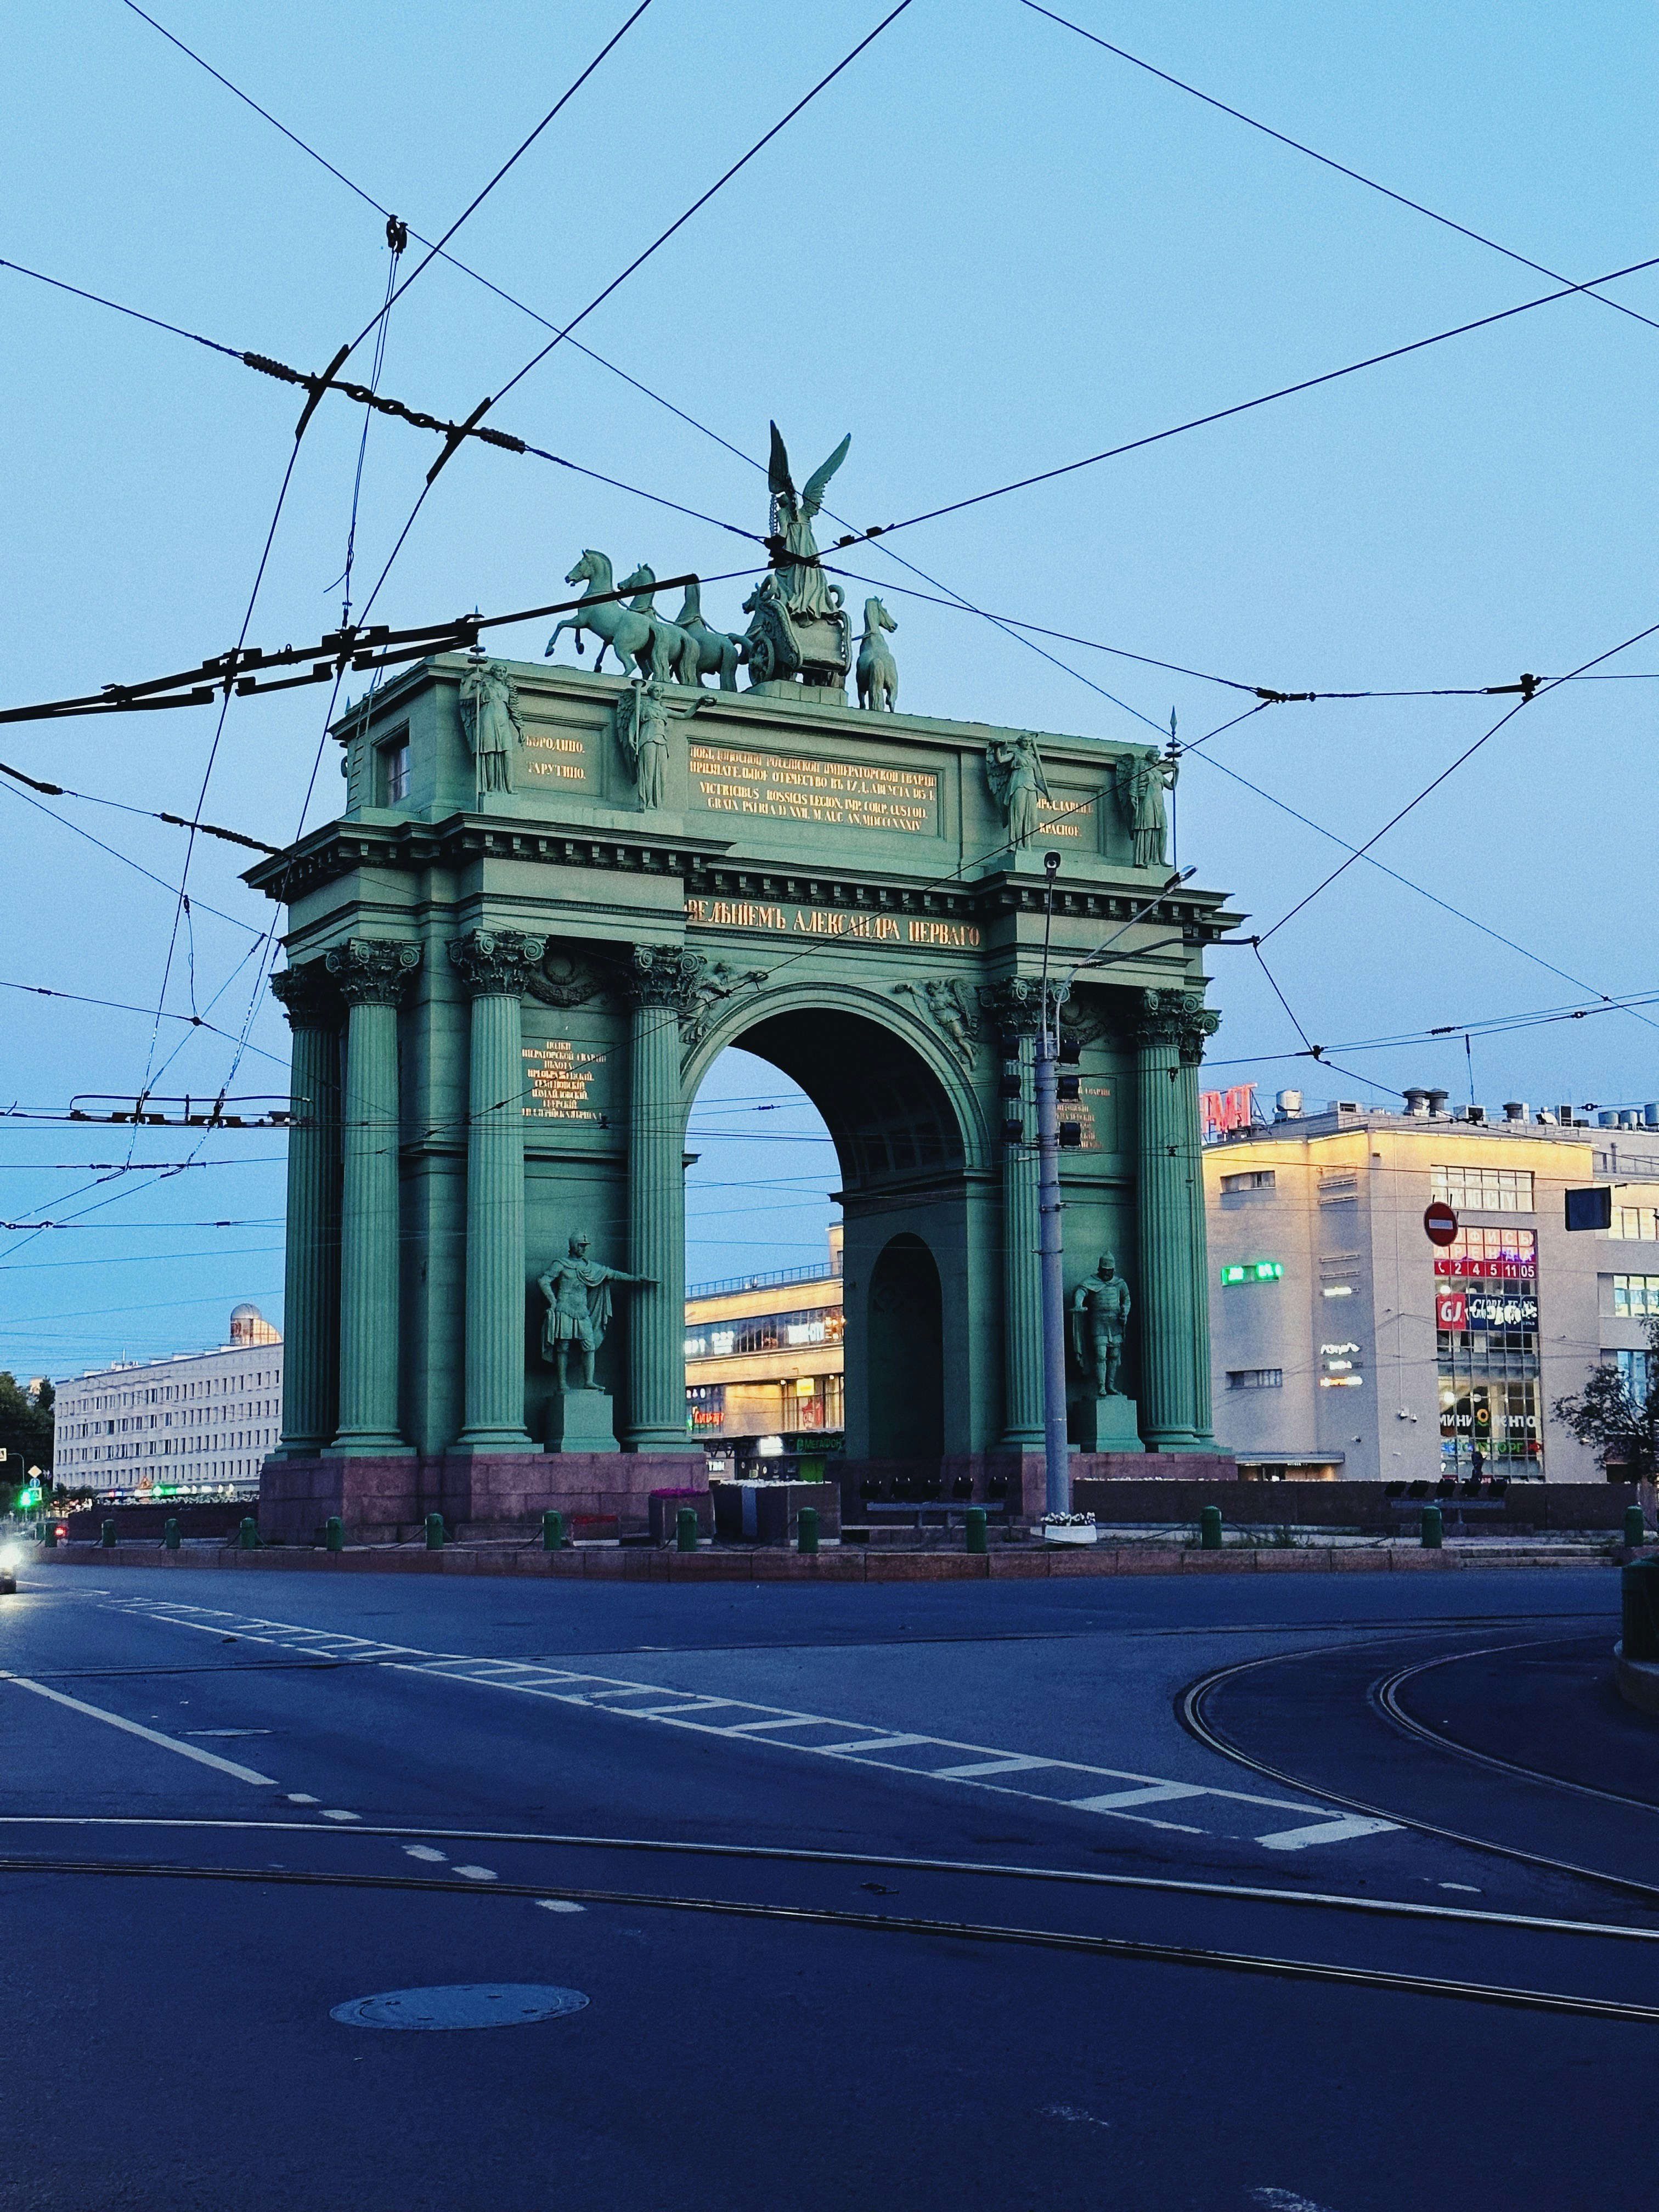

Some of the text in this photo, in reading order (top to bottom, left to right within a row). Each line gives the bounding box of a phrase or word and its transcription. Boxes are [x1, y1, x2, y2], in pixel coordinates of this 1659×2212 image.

[772, 771, 827, 787] ОТЕЧЕСТВО
[699, 781, 760, 799] VICTRICIBUS
[766, 789, 808, 805] ROSSICIS
[684, 899, 981, 946] ВЕЛѢНІЕМЪ АЛЕКСАНДРА ПЕРВАГО
[1437, 1245, 1532, 1261] АРЕНДА
[1441, 1301, 1462, 1322] GJ
